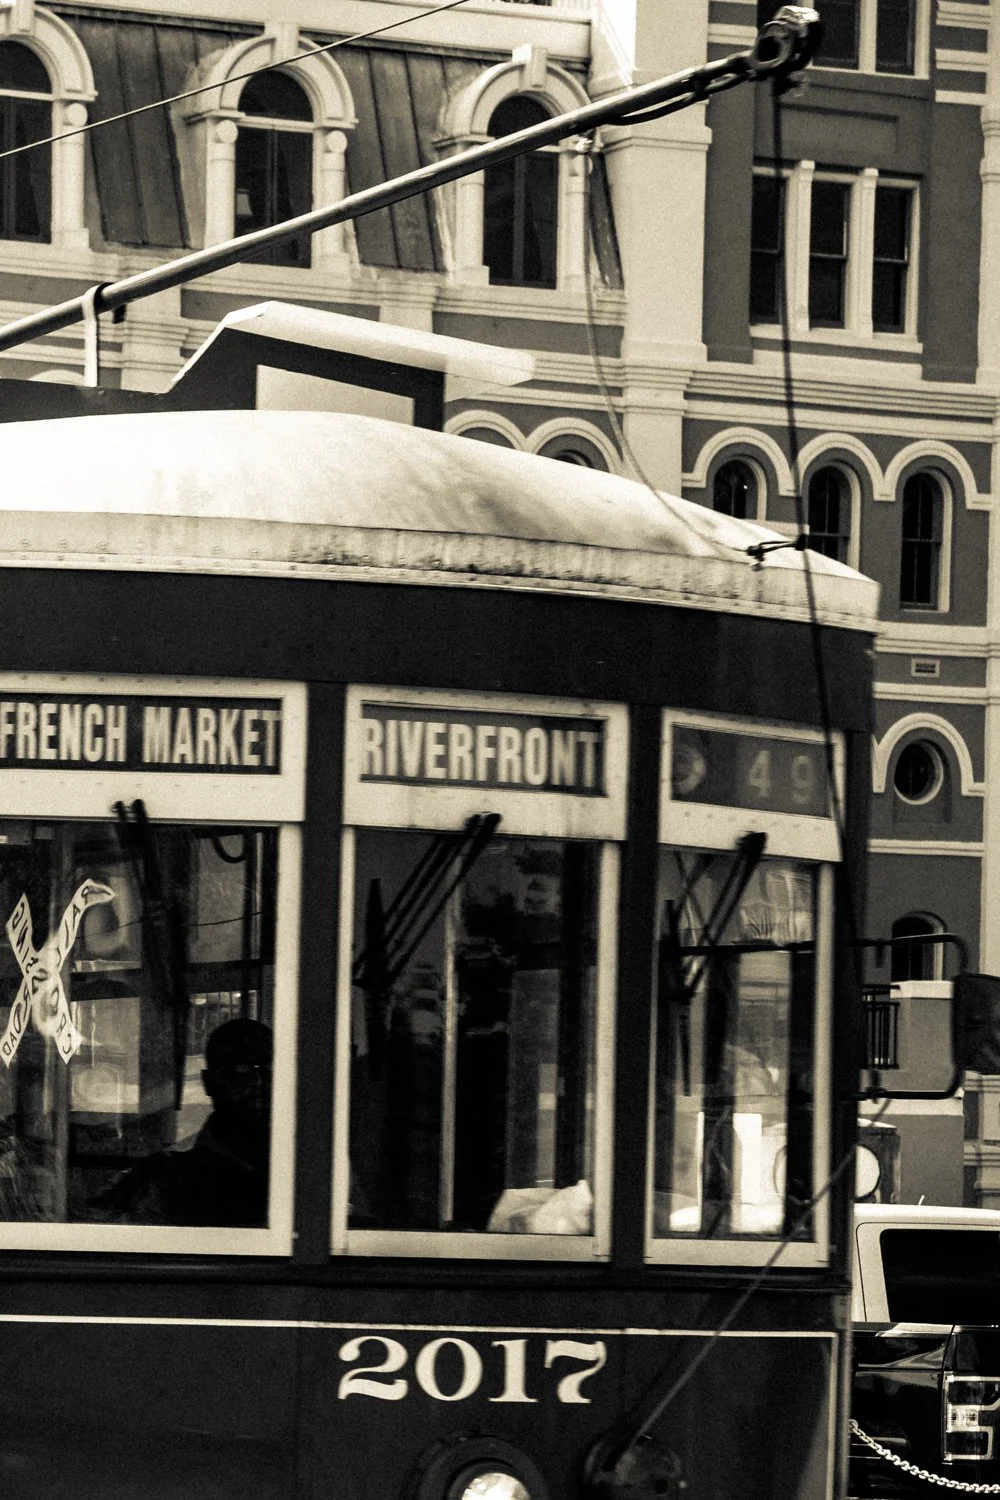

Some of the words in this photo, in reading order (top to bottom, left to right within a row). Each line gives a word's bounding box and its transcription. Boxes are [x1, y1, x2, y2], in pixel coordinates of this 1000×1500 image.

[143, 706, 281, 767] MARKET
[360, 718, 600, 787] RIVERFRONT
[338, 1335, 606, 1404] 2017
